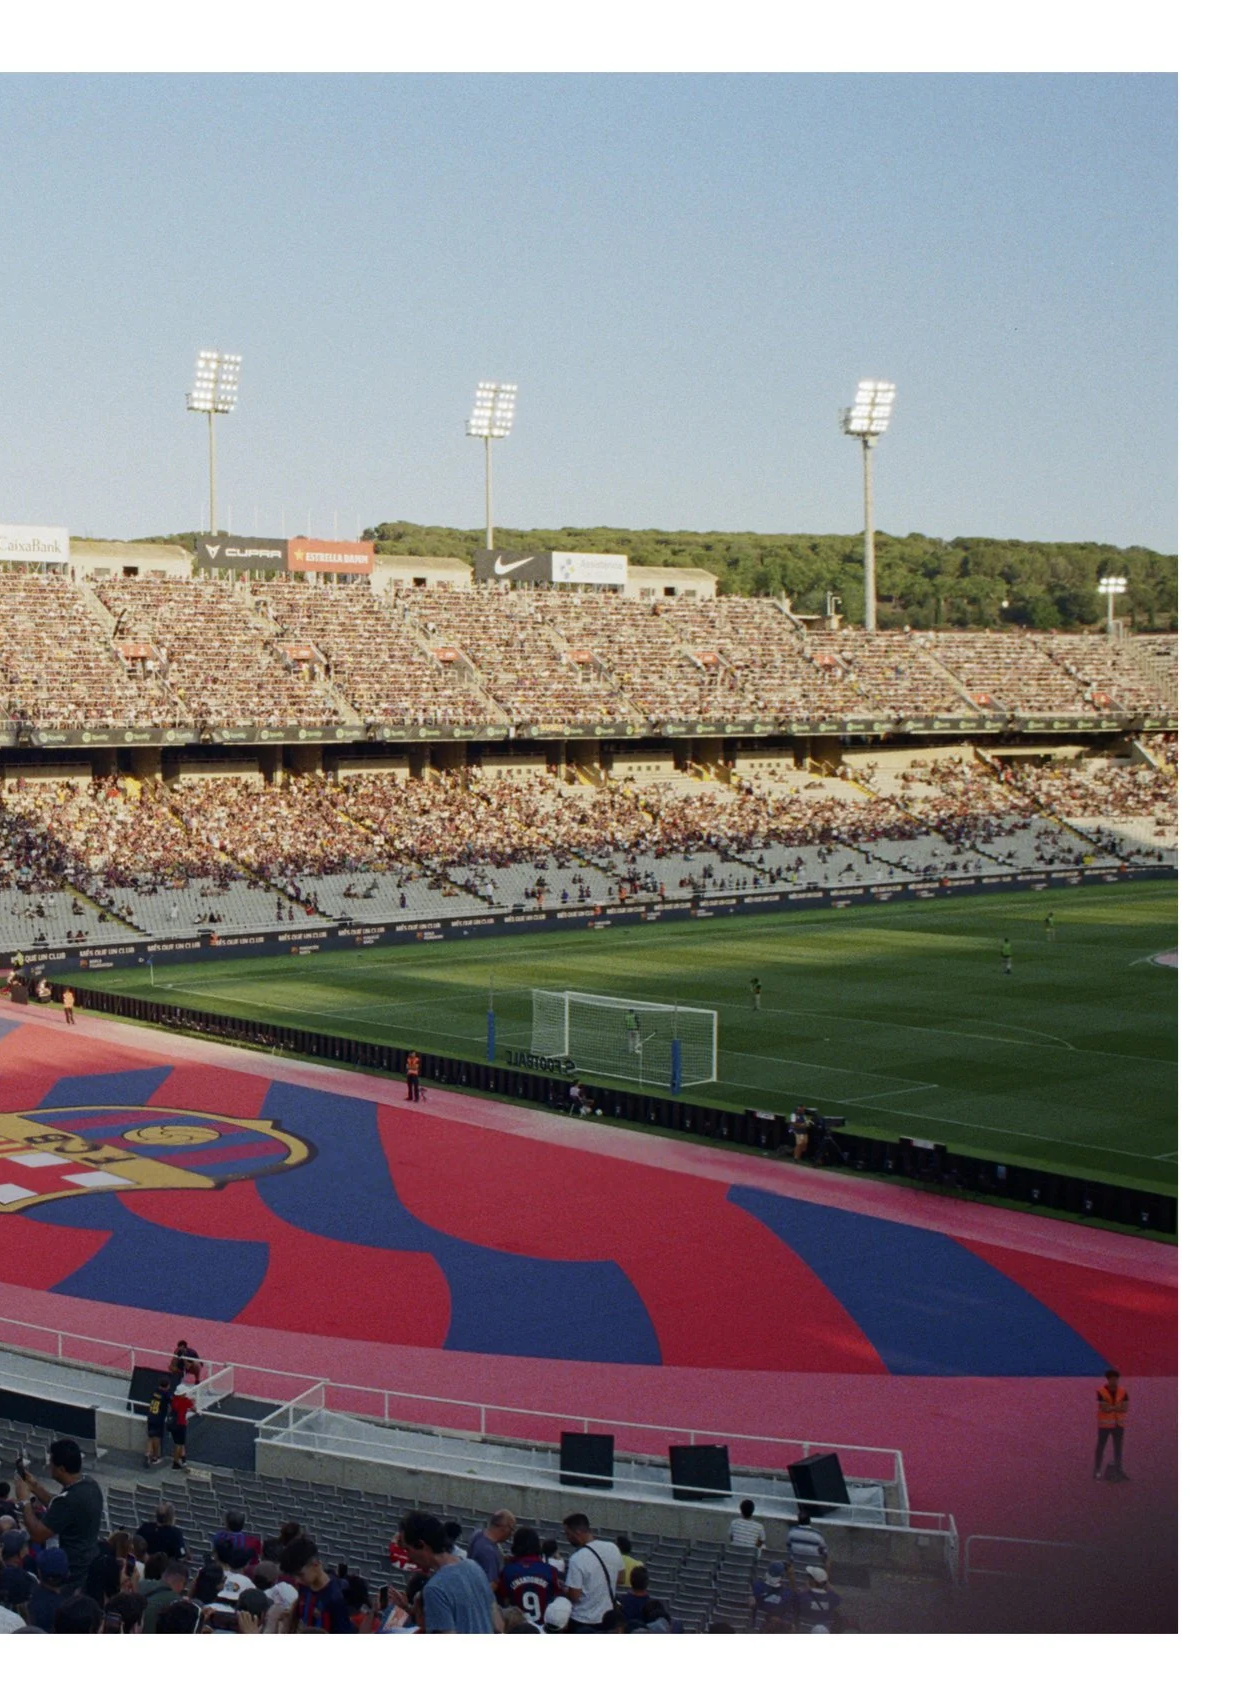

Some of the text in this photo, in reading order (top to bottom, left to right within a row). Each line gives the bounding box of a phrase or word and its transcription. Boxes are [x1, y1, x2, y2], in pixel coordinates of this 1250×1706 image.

[225, 548, 281, 558] CUPRA
[305, 552, 342, 563] ESTRELLA
[95, 949, 107, 957] QUE
[119, 946, 135, 955] CLUB
[25, 954, 37, 963] QUE
[38, 953, 48, 961] UN
[49, 952, 66, 960] CLUB
[522, 1591, 541, 1622] 9
